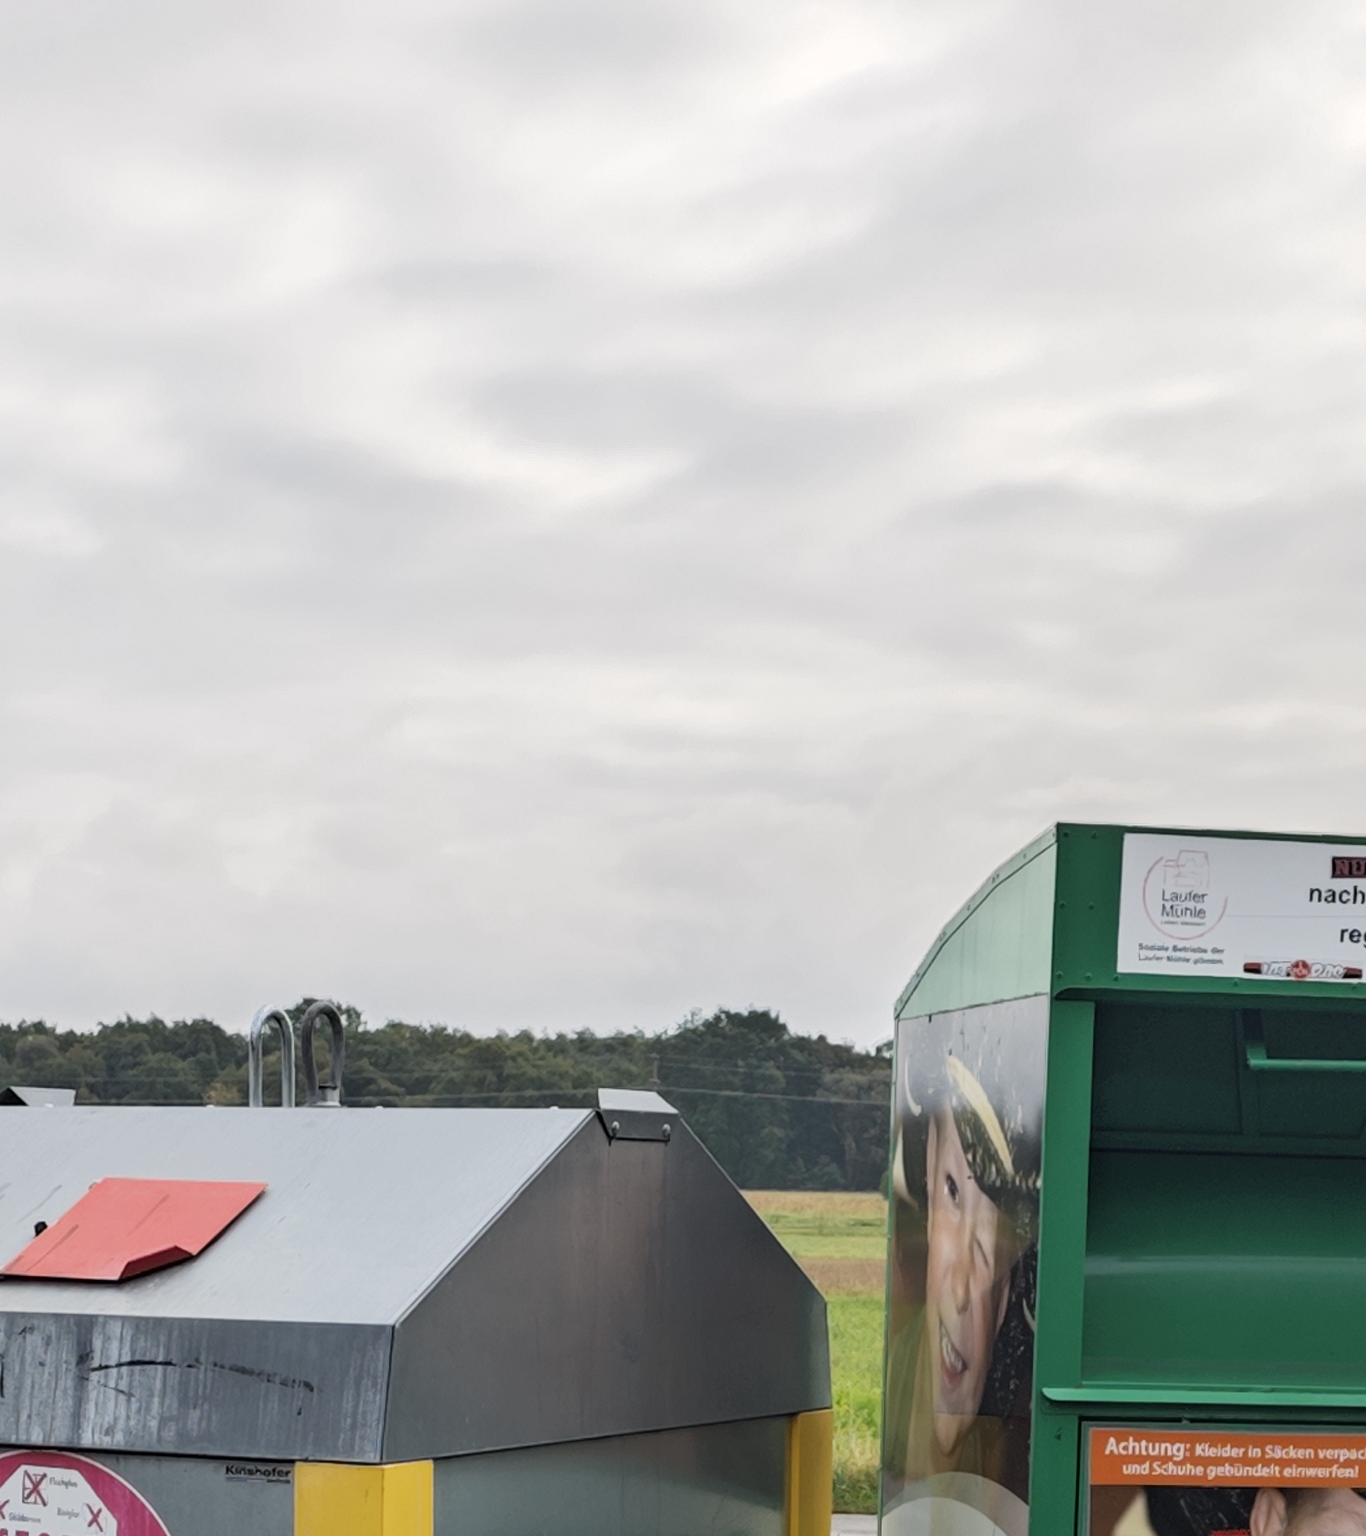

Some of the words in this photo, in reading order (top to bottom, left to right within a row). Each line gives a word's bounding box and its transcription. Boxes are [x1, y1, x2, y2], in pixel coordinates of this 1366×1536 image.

[1161, 888, 1209, 904] Laufer
[1105, 1436, 1190, 1460] Achtung:
[1195, 1442, 1245, 1458] Kleider
[1248, 1444, 1261, 1458] in
[1265, 1445, 1314, 1460] Säcken
[1122, 1463, 1149, 1475] und
[1152, 1462, 1204, 1476] Schuhe
[1206, 1464, 1280, 1480] gebündelt
[1283, 1465, 1359, 1478] einwerfen!
